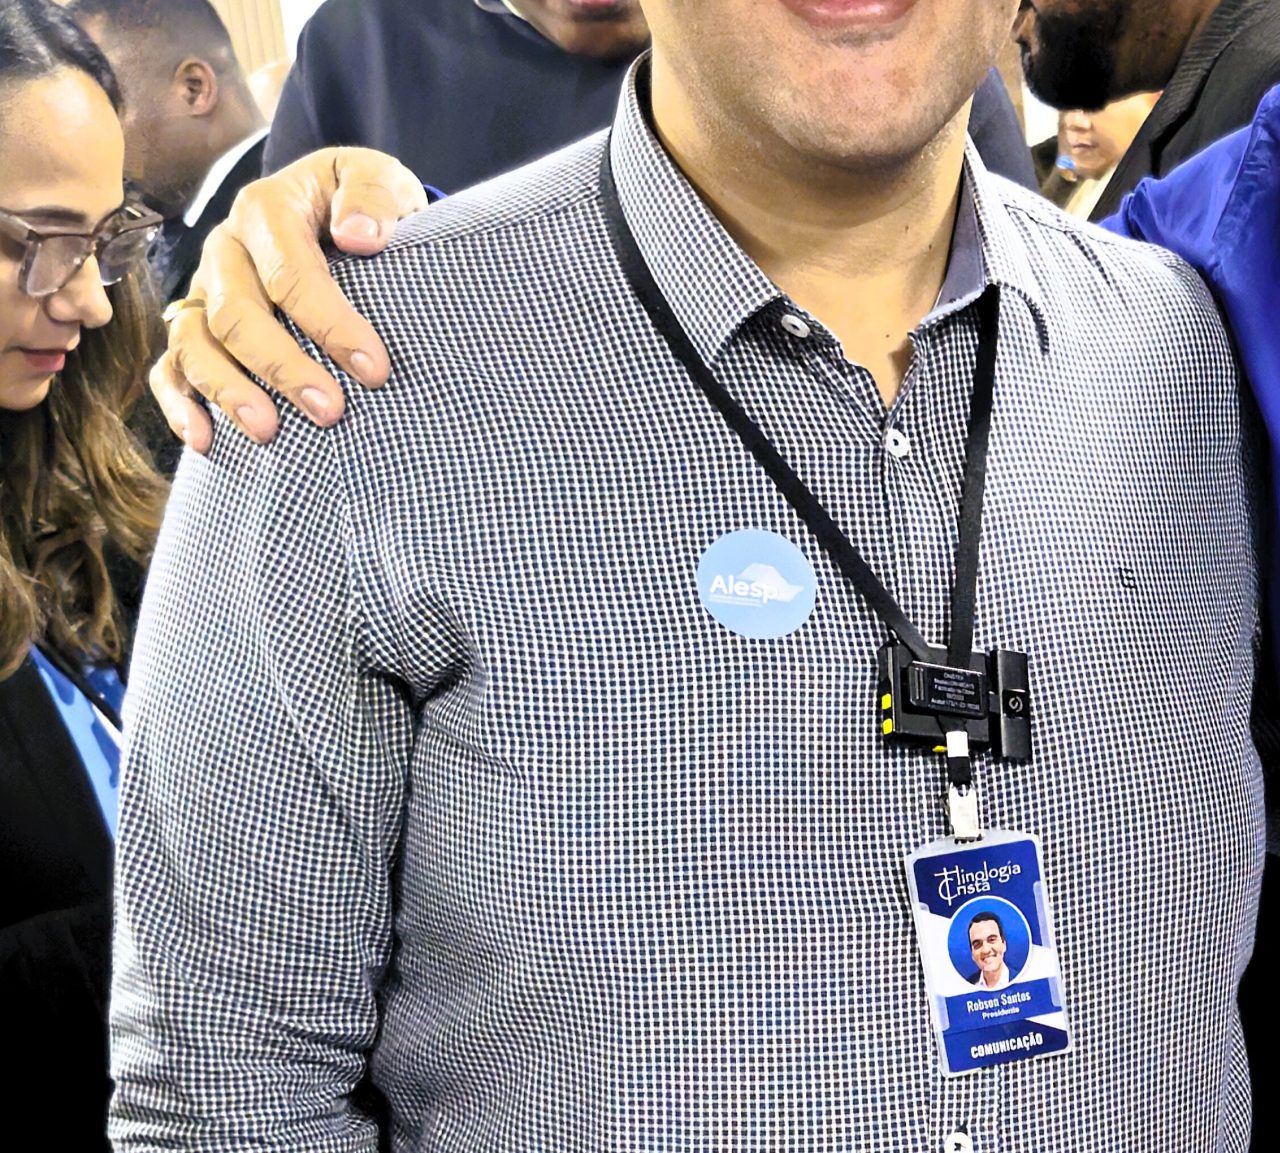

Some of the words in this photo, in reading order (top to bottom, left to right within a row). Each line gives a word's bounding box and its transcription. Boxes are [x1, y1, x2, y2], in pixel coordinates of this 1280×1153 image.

[709, 574, 778, 605] Alesp
[967, 998, 999, 1013] Robson
[1001, 992, 1031, 1005] Santos
[982, 1007, 1020, 1019] Presidente
[970, 1032, 1044, 1058] COMUNICAÇÃO
